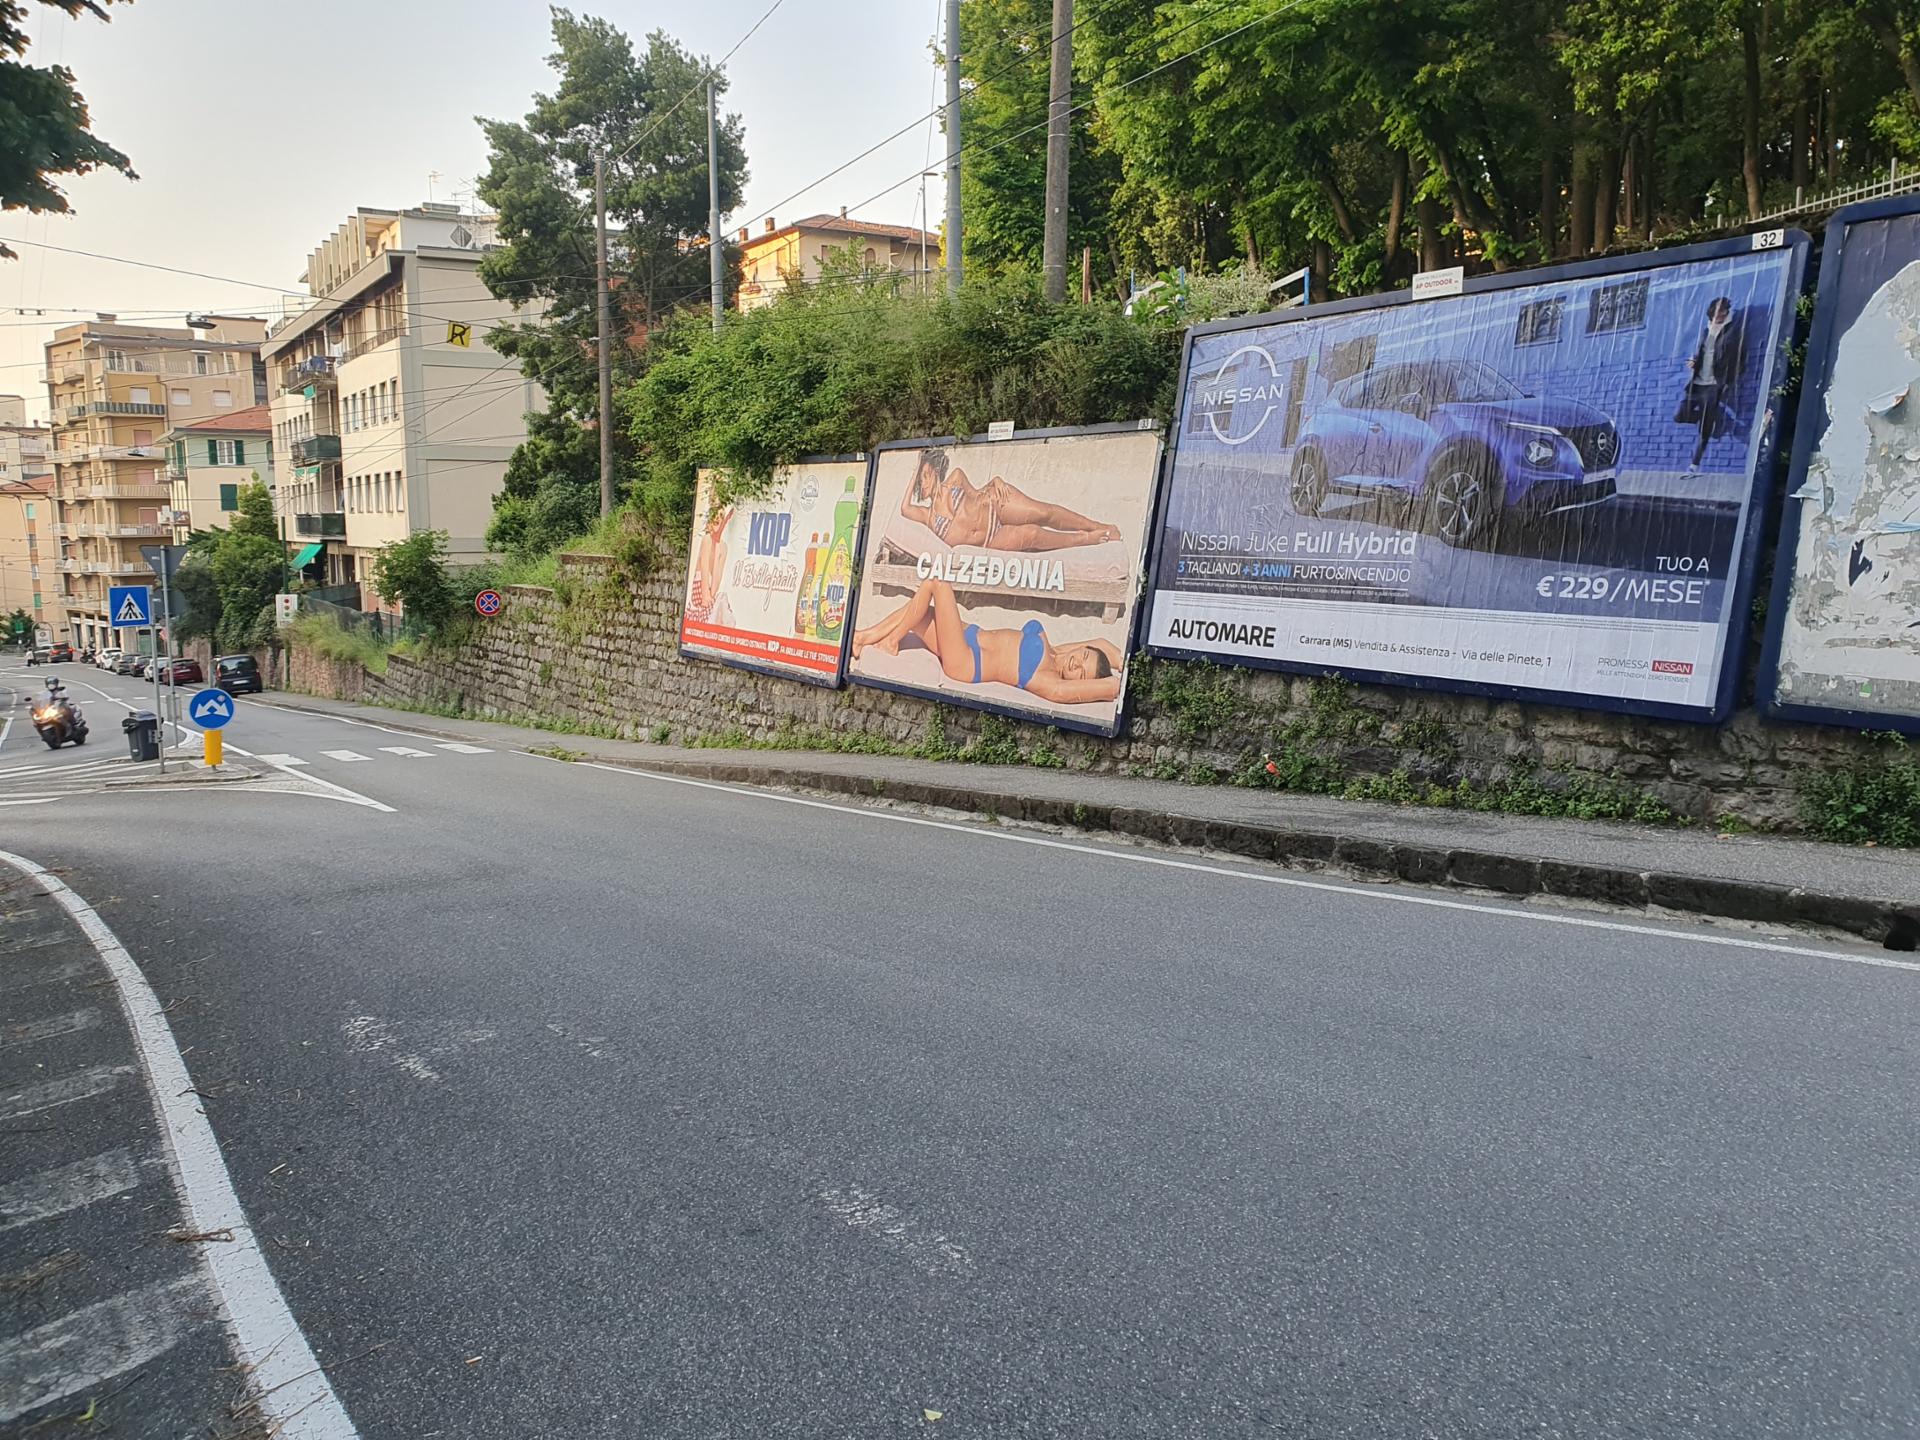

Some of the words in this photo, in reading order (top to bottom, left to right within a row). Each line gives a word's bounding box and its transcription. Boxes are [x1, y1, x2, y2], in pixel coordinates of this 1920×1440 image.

[1760, 232, 1777, 247] 32
[1202, 384, 1284, 407] NISSAN
[747, 511, 792, 558] KOP
[1181, 530, 1241, 551] Nissan
[1244, 531, 1289, 553] Juke
[1293, 530, 1333, 554] Full
[1338, 530, 1417, 560] Hybrid
[916, 551, 1065, 592] CALZEDONIA
[1177, 560, 1185, 573] 3
[1187, 561, 1242, 576] TAGLIANDI
[1251, 563, 1259, 576] 3
[1260, 563, 1292, 578] ANNI
[1293, 564, 1411, 583] FURTO&INCENDIO
[1656, 556, 1693, 572] TUO
[1696, 557, 1709, 572] A
[1536, 576, 1555, 598] €
[1168, 618, 1277, 648] AUTOMARE
[1299, 635, 1331, 647] Carrara
[1332, 637, 1353, 650] (MS)
[1354, 639, 1388, 652] Vendita
[1390, 643, 1397, 653] &
[1399, 643, 1450, 658] Assistenza
[1461, 649, 1478, 660] Via
[1480, 650, 1505, 662] delle
[1507, 653, 1544, 667] Pinete,
[1547, 656, 1552, 667] 1
[1598, 657, 1649, 669] PROMESSA
[1653, 662, 1691, 673] NISSAN
